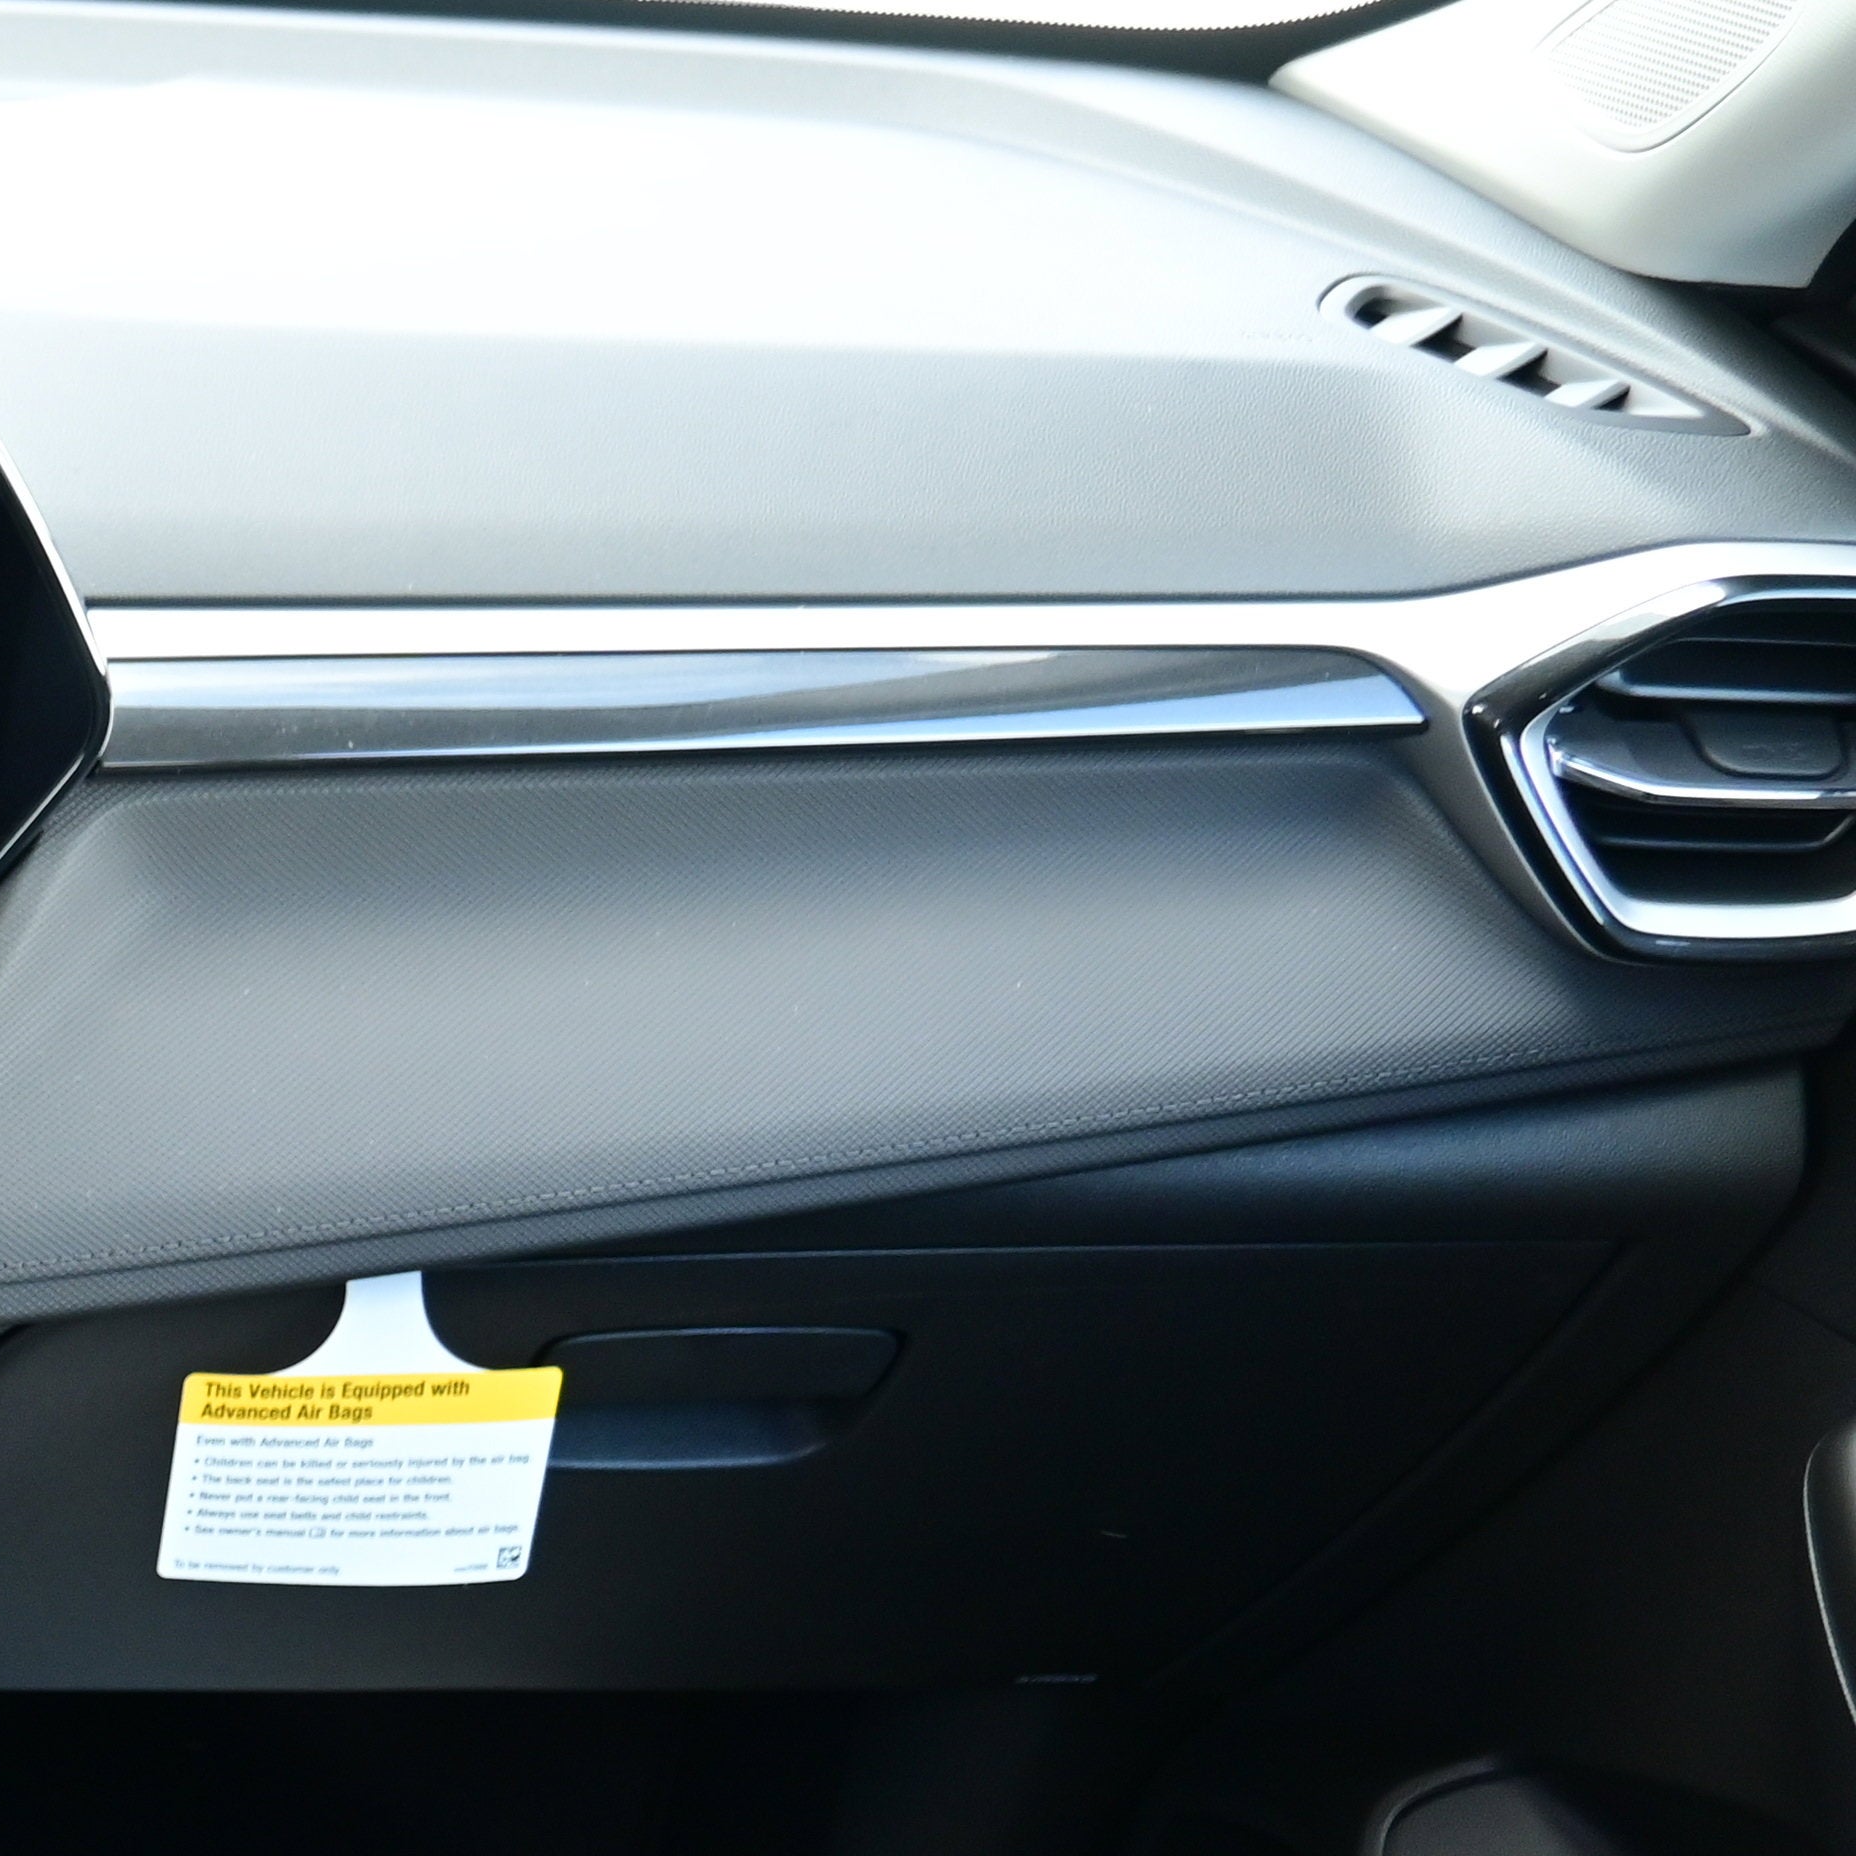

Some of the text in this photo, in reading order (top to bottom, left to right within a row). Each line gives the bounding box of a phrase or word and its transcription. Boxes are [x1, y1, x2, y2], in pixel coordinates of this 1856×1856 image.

[205, 1379, 471, 1400] This Vehicle is Equipped with
[201, 1403, 374, 1423] Advanced Air Bags
[230, 1436, 256, 1447] with
[260, 1436, 320, 1447] Advanced
[324, 1437, 339, 1447] Air
[344, 1437, 374, 1449] Bags
